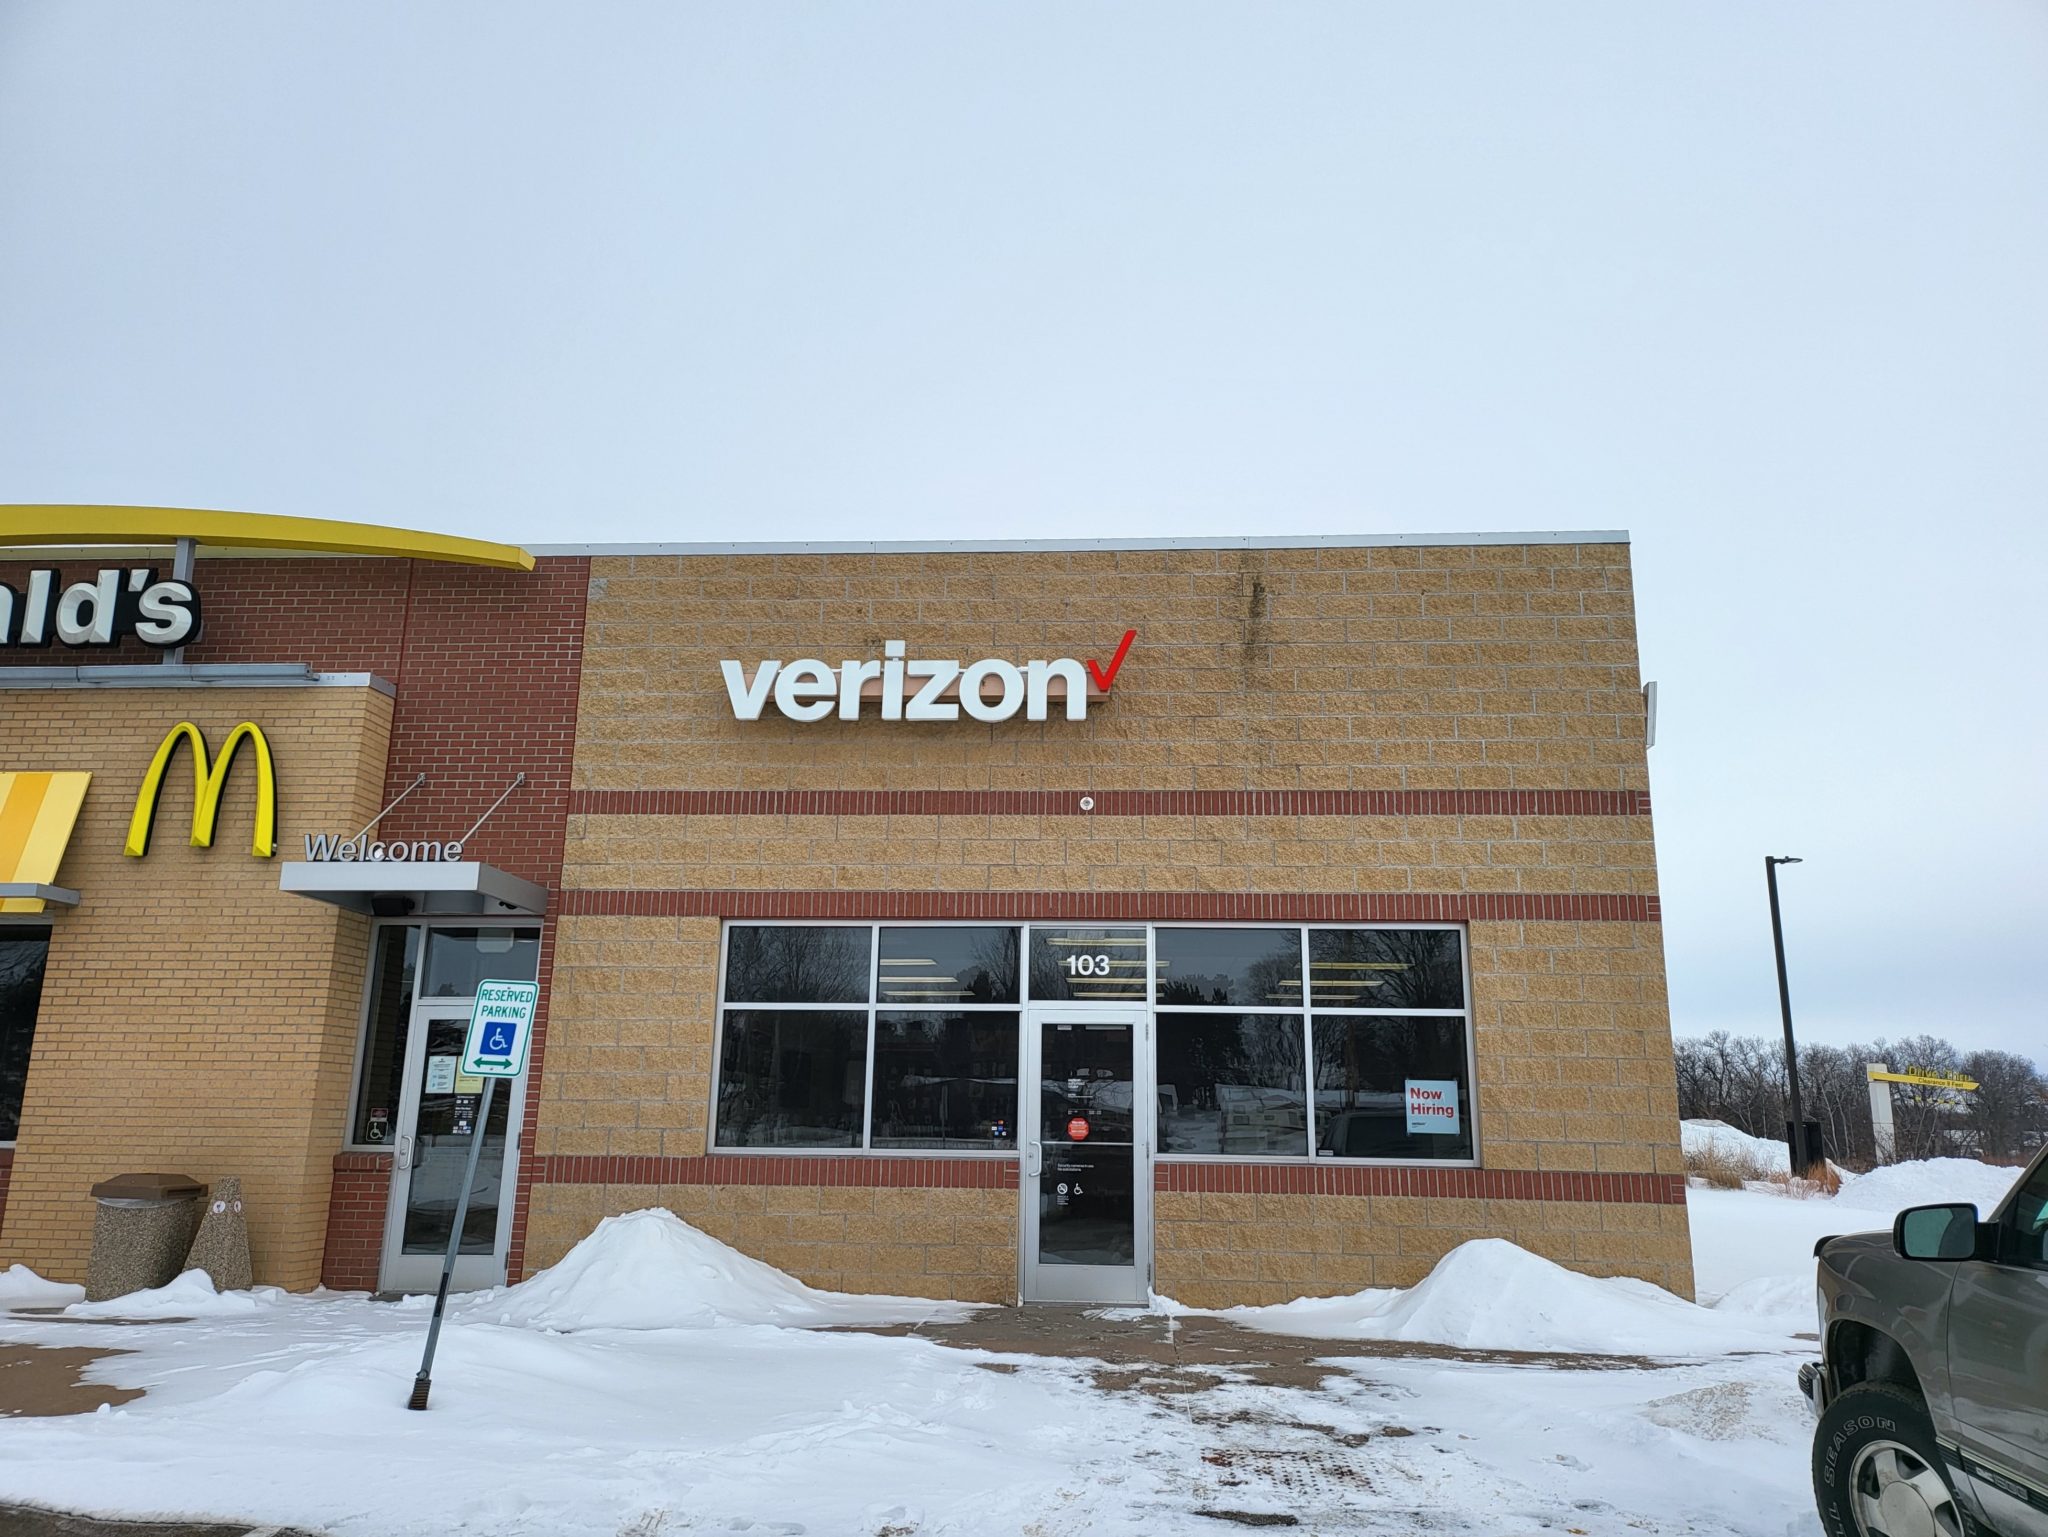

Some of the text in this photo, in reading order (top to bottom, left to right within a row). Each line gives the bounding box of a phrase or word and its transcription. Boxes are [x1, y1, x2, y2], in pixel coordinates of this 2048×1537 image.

[0, 568, 193, 645] ld's
[720, 640, 1088, 723] verizon
[304, 834, 463, 862] Welcome
[1067, 954, 1110, 976] 103
[480, 989, 533, 1003] RESERVED
[480, 1005, 527, 1019] PARKING
[1410, 1088, 1442, 1100] Now
[1411, 1103, 1454, 1118] Hiring
[1823, 1415, 1896, 1488] SEASON
